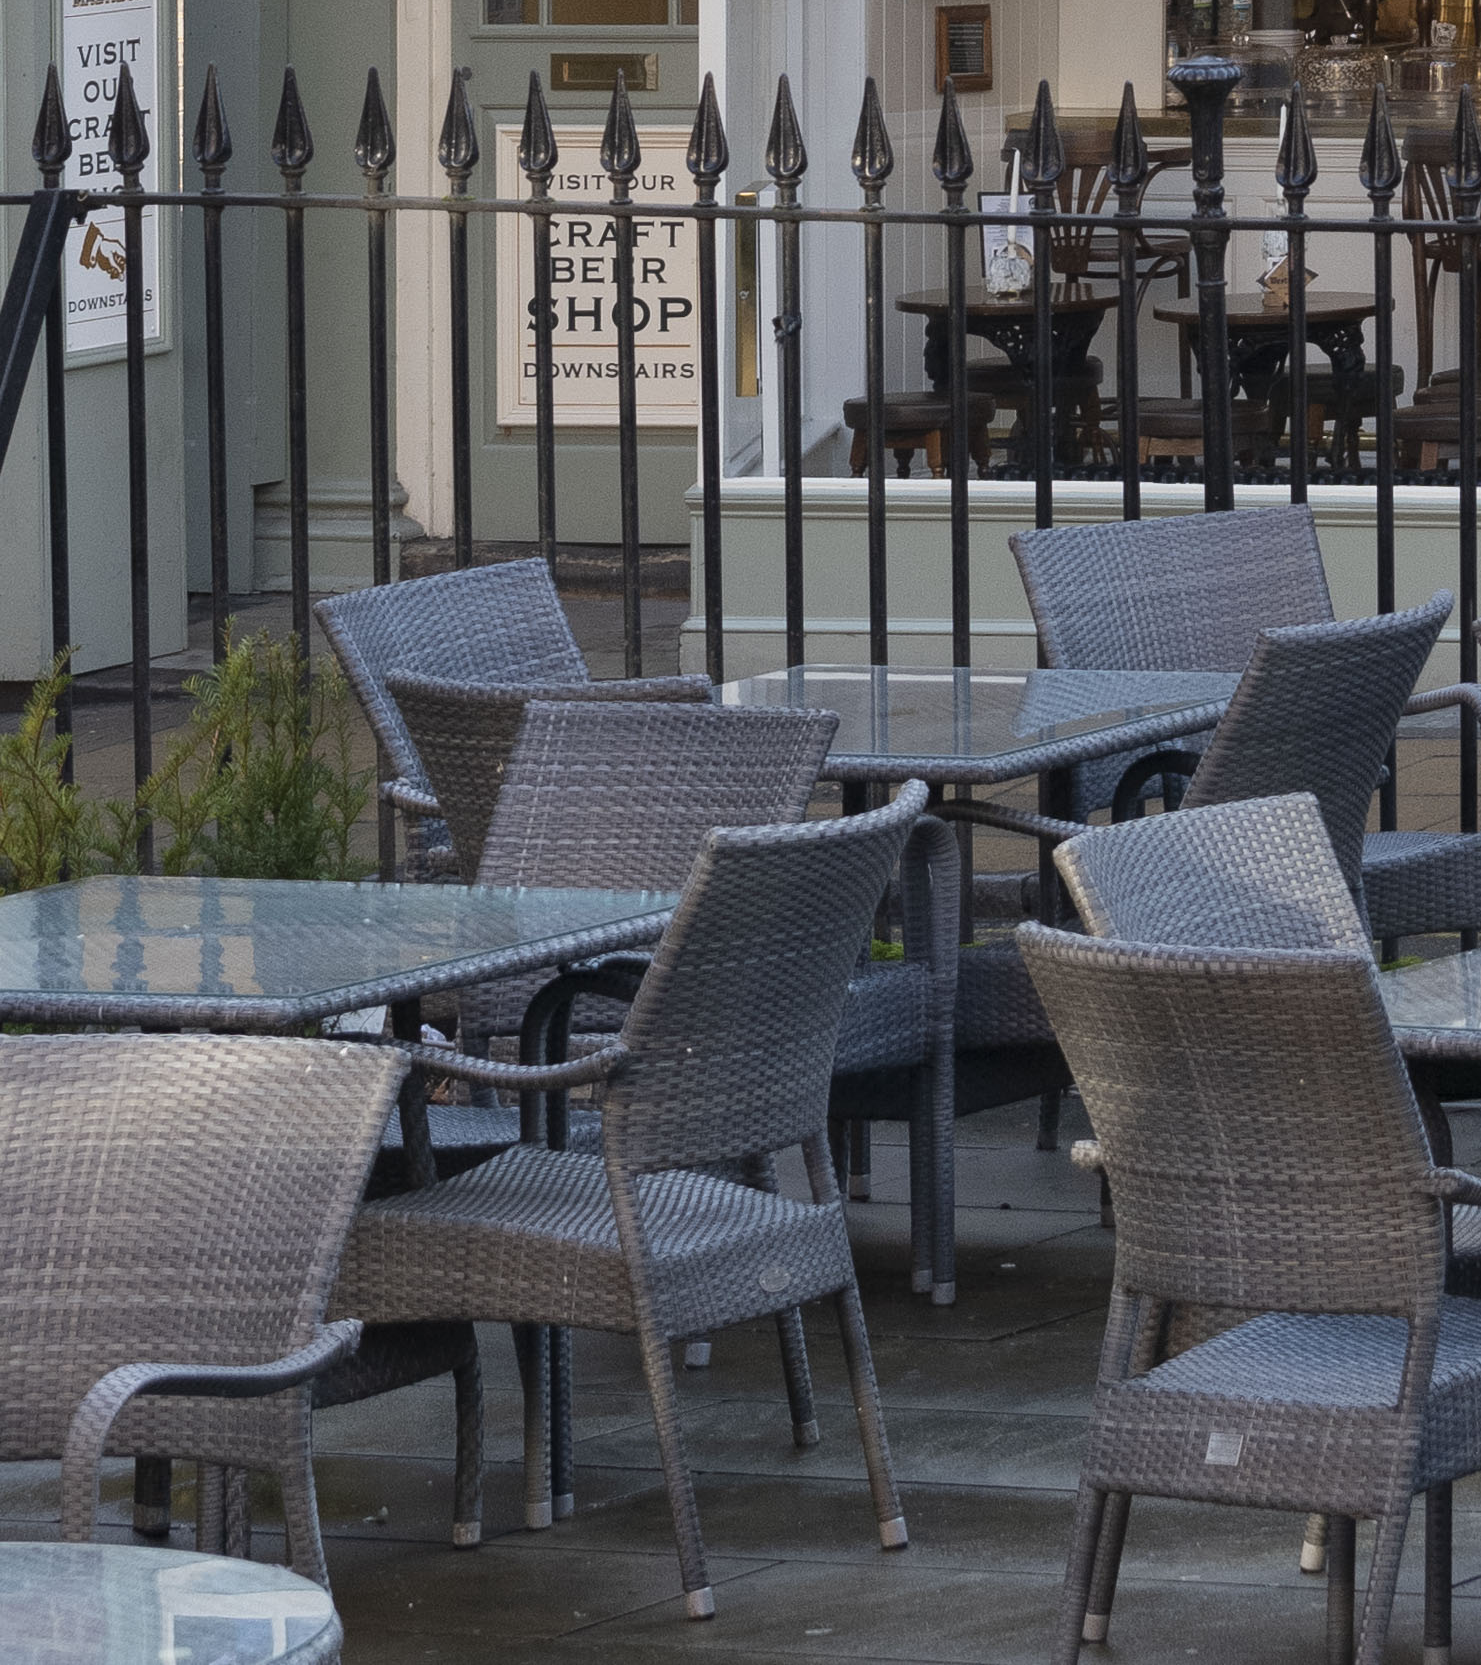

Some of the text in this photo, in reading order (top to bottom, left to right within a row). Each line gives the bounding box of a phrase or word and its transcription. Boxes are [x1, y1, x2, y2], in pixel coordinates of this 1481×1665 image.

[77, 37, 140, 68] VISIT
[84, 77, 118, 102] OU
[523, 363, 695, 379] DOWNSAIRS
